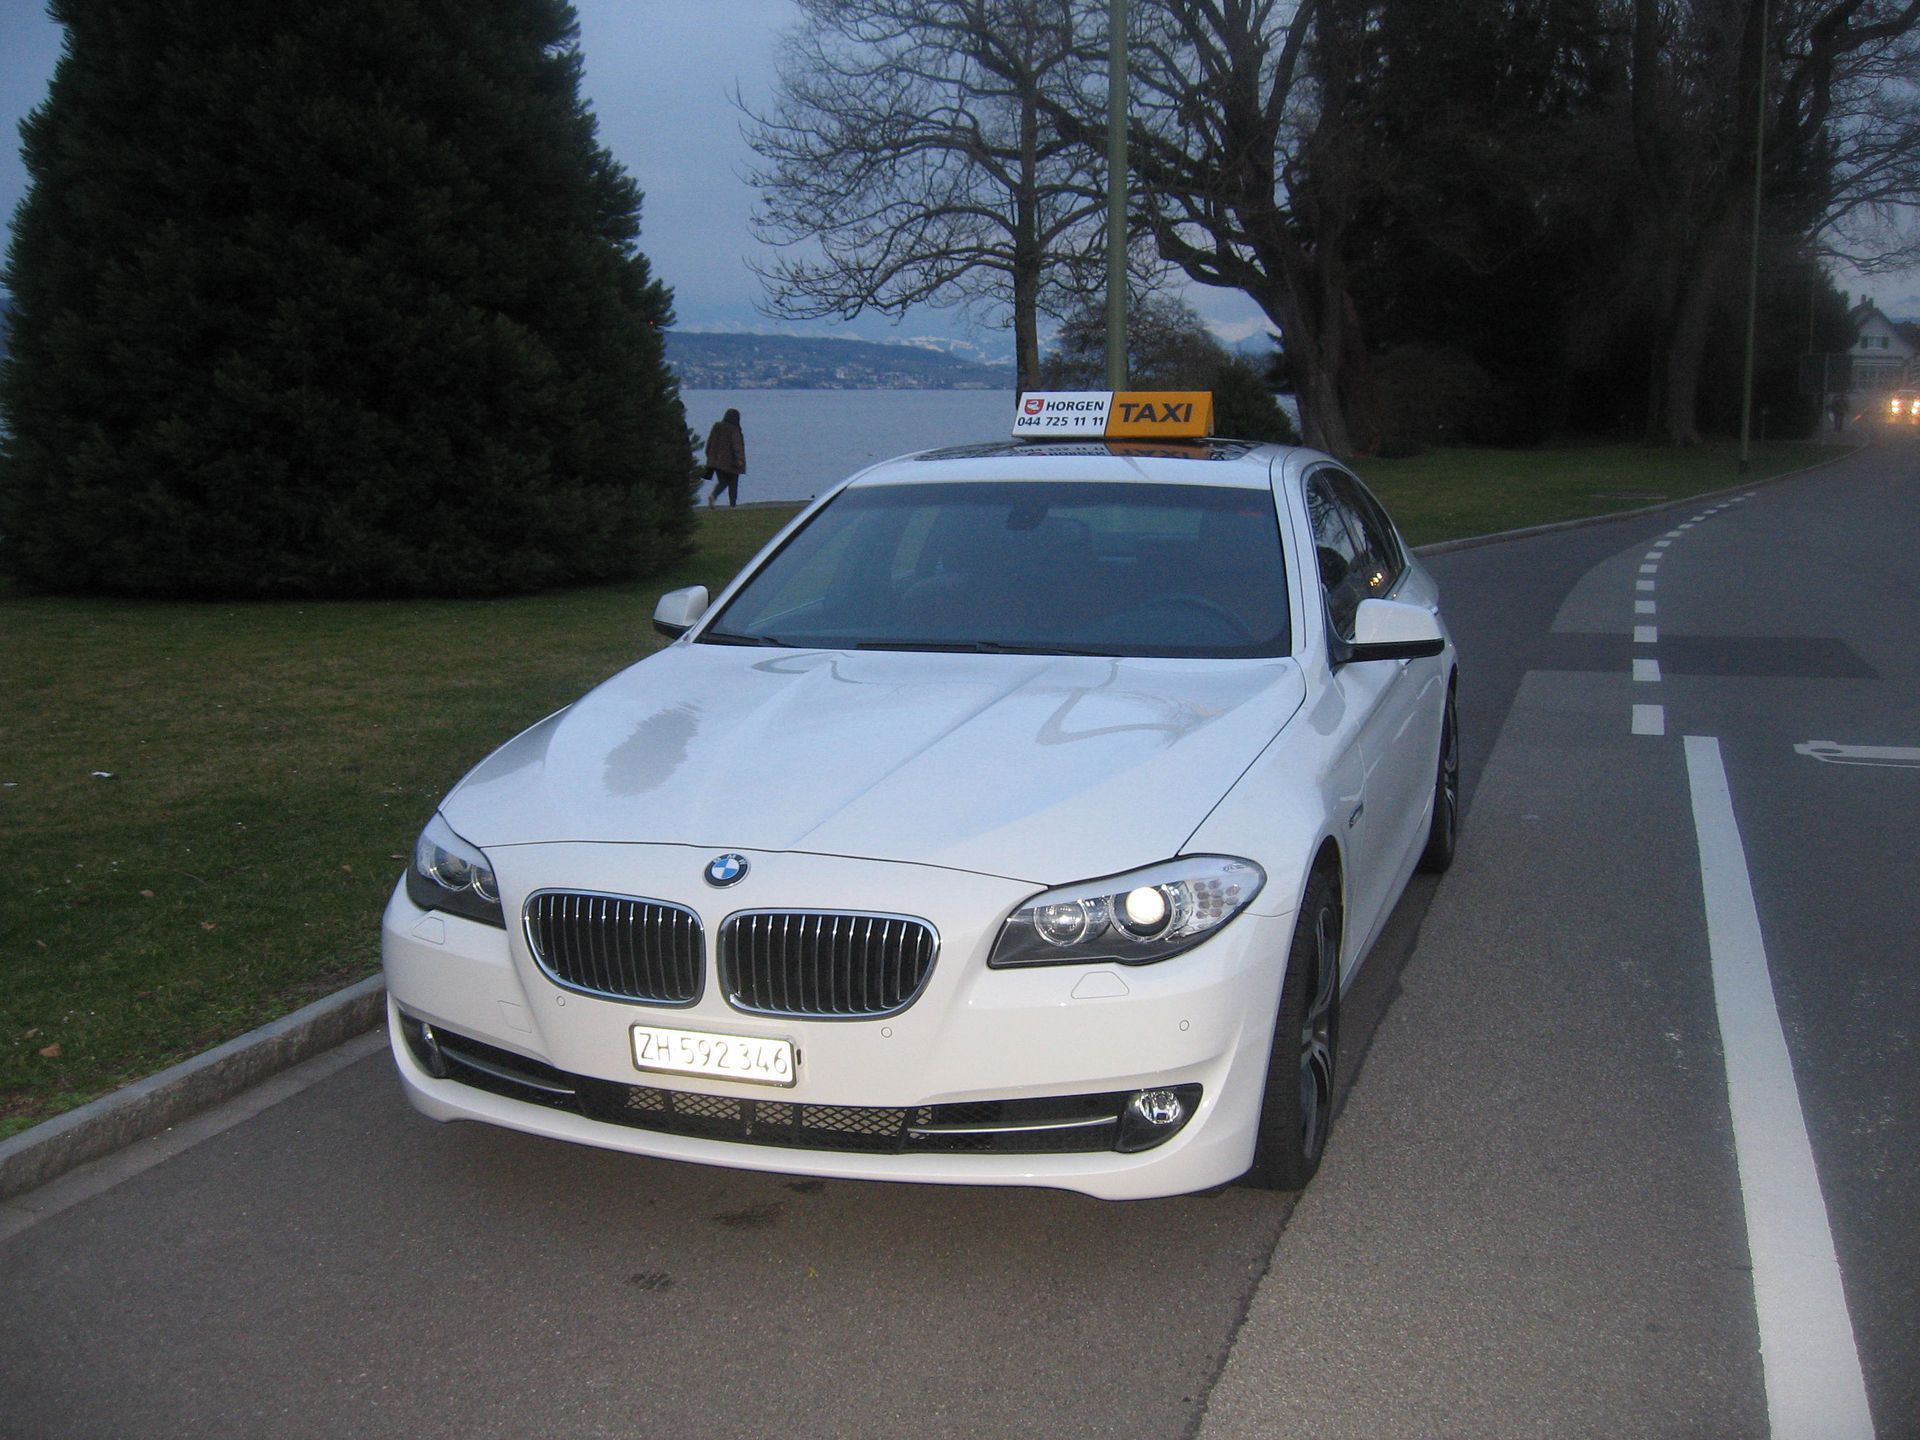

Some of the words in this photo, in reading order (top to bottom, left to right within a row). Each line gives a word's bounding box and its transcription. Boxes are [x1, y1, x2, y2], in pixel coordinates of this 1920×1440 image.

[1046, 401, 1104, 411] HORGEN
[1119, 403, 1192, 423] TAXI
[1017, 416, 1040, 426] 044
[1046, 416, 1068, 426] 725
[1074, 416, 1086, 426] 11
[1092, 416, 1104, 426] 11
[639, 1032, 671, 1062] ZH
[680, 1037, 730, 1069] 592
[739, 1043, 788, 1075] 346
